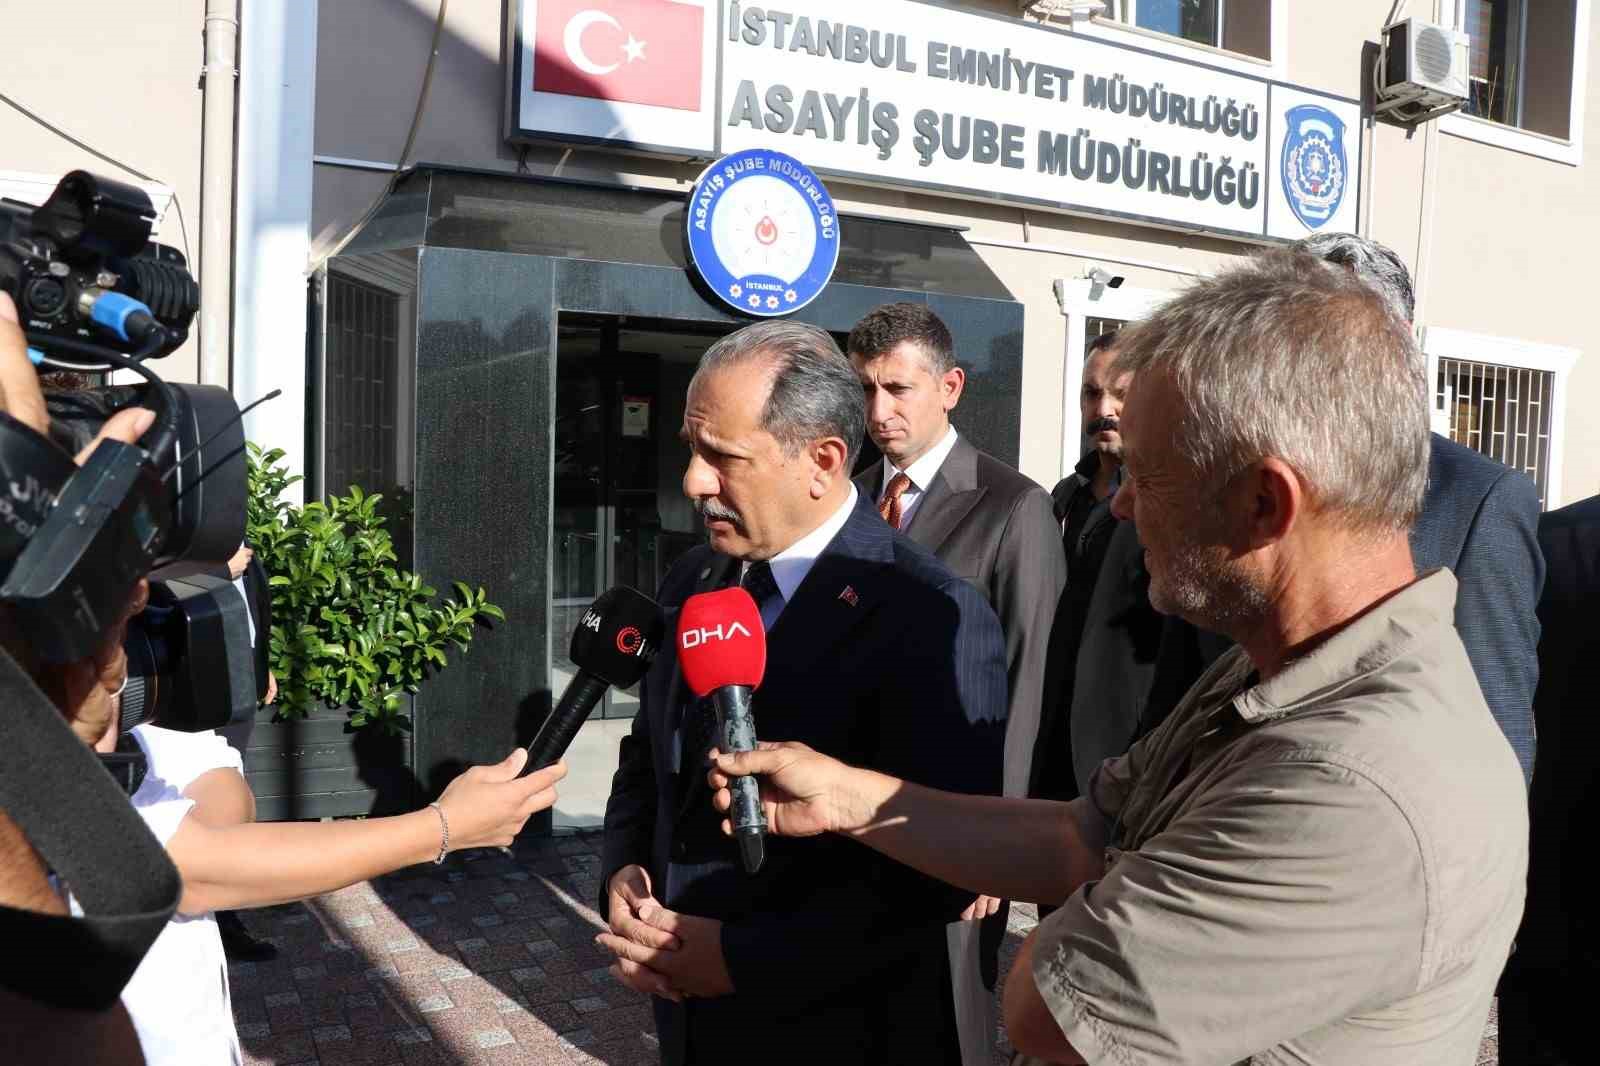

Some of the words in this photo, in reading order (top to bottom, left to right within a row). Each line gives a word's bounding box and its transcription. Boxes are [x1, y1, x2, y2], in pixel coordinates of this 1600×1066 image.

[729, 0, 916, 73] İSTANBUL
[928, 41, 1074, 102] EMNİYET
[1083, 73, 1259, 142] MÜDÜRLÜĞÜ
[728, 80, 900, 161] ASAYİŞ
[913, 109, 1025, 169] ŞUBE
[1037, 128, 1259, 209] MÜDÜRLÜĞÜ
[682, 621, 752, 649] DHA
